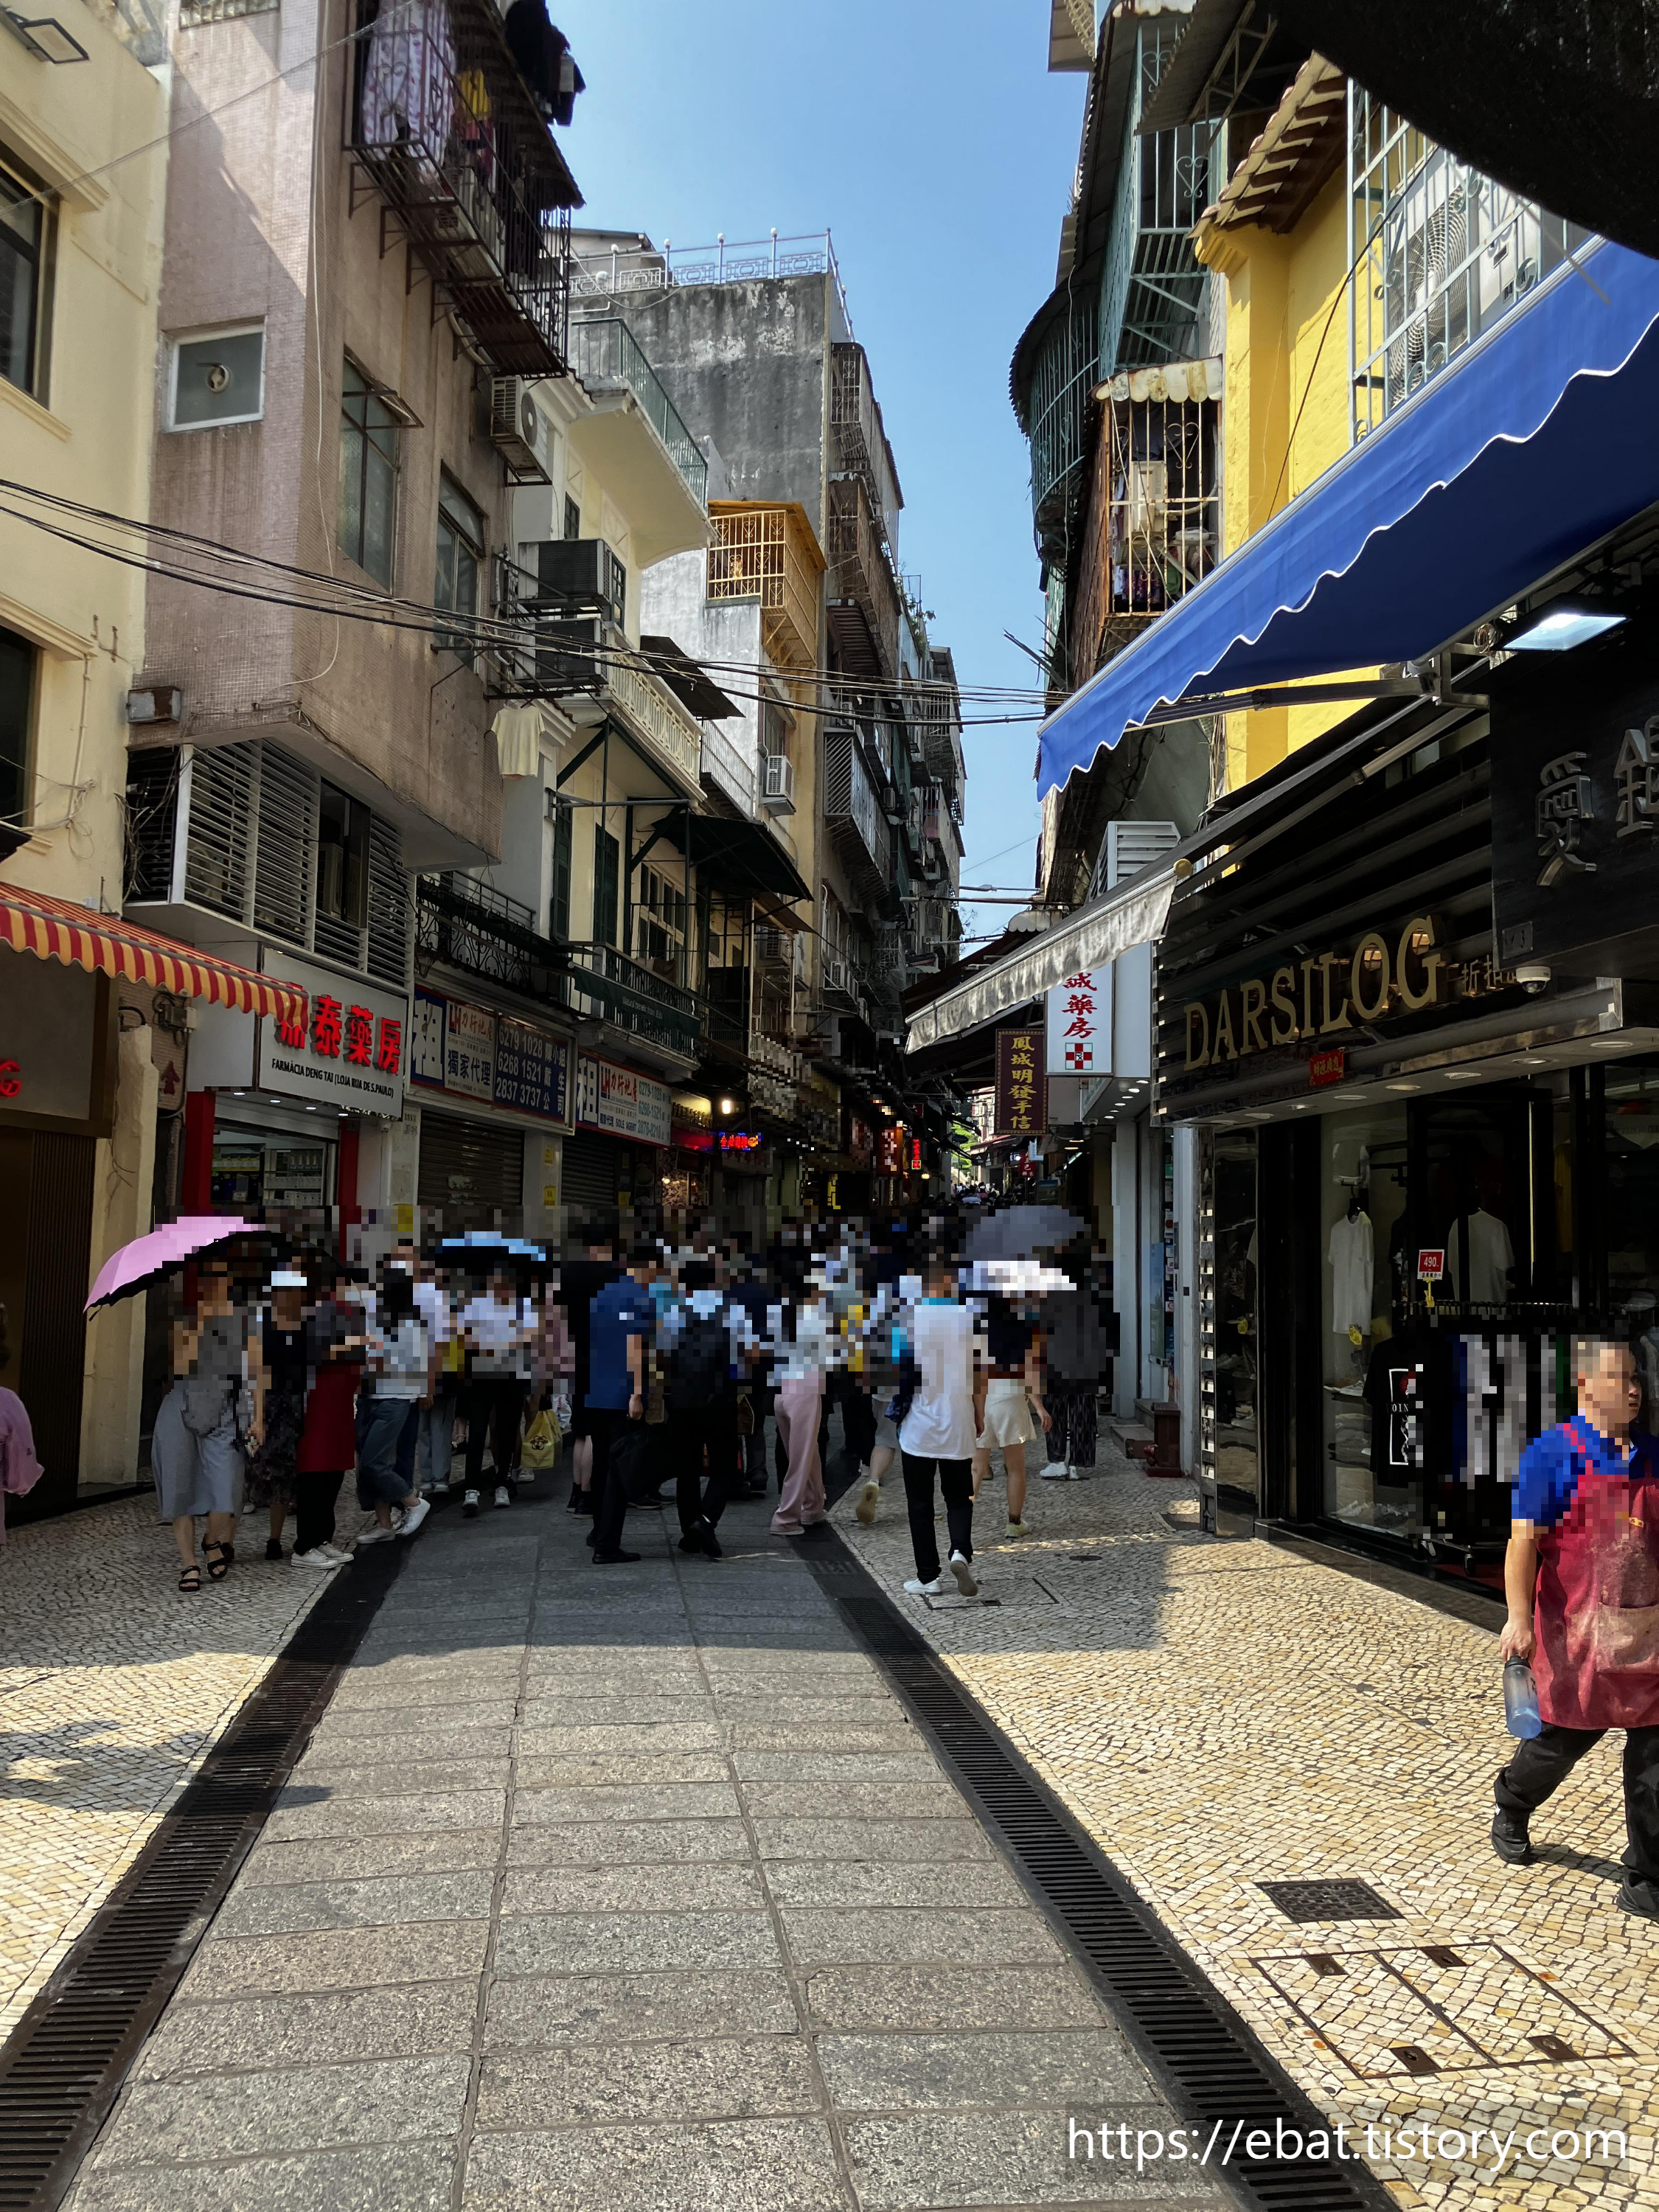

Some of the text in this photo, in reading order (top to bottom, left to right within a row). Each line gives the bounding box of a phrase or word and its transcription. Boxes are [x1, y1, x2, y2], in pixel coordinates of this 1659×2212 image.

[1183, 914, 1441, 1071] DARSILOG
[412, 998, 443, 1081] 租
[498, 1025, 519, 1051] 6279
[522, 1034, 543, 1059] 1028
[305, 1068, 323, 1080] DENG
[324, 1071, 334, 1082] TAI
[335, 1074, 351, 1087] (LOJA
[351, 1079, 363, 1089] RUA
[363, 1081, 370, 1091] DE
[370, 1082, 394, 1099] S.PAULO)
[448, 1048, 490, 1086] 獨家代理
[498, 1051, 518, 1077] 6268
[521, 1060, 541, 1083] 1521
[1007, 1035, 1037, 1130] 鳳城明發手信
[495, 1077, 518, 1102] 2837
[520, 1083, 541, 1108] 3737
[577, 1057, 598, 1124] 租
[616, 1118, 625, 1129] SOLE
[625, 1121, 636, 1132] AGENT
[1424, 1256, 1437, 1267] 490
